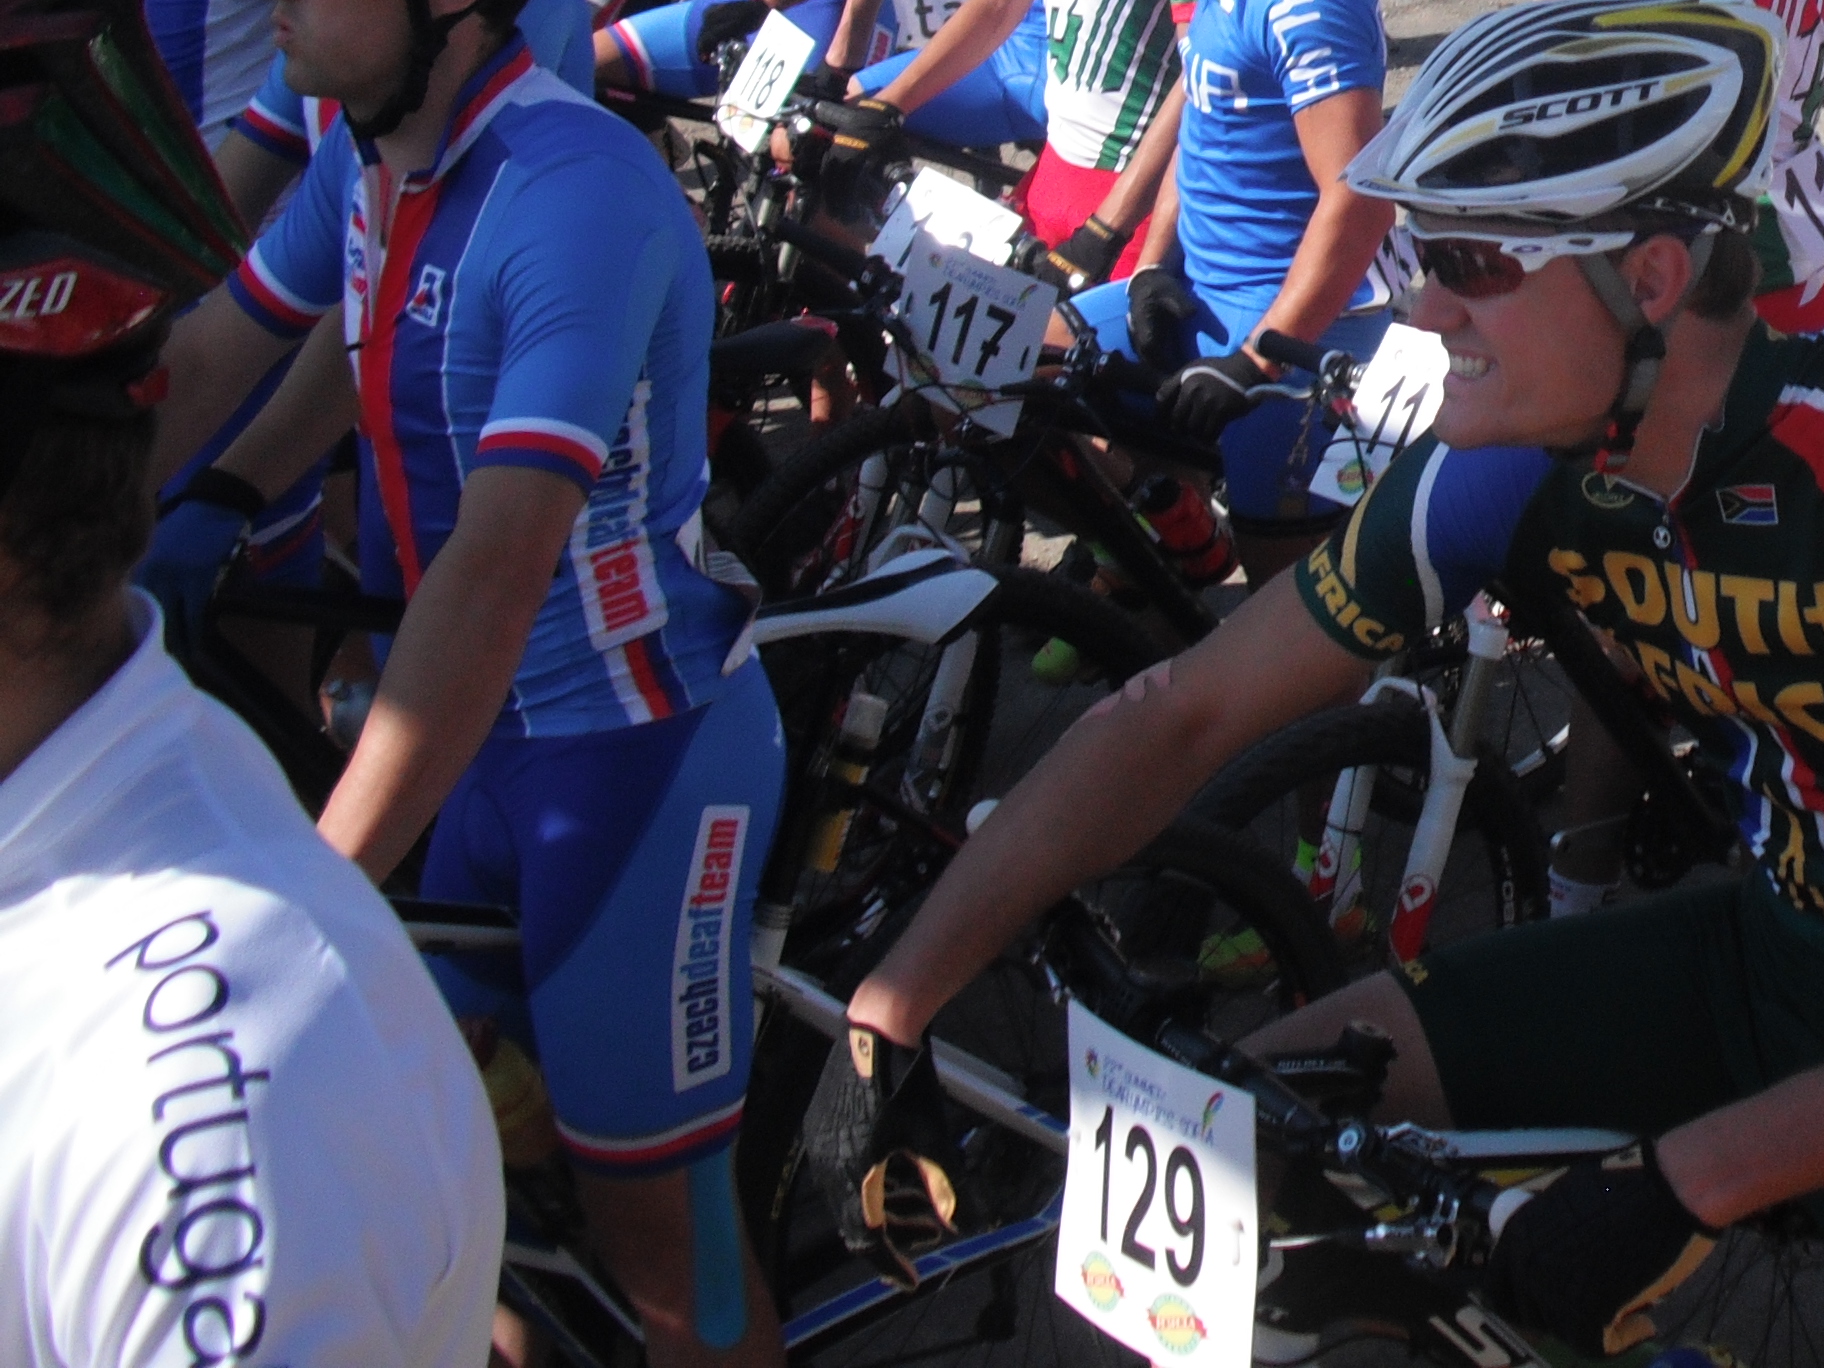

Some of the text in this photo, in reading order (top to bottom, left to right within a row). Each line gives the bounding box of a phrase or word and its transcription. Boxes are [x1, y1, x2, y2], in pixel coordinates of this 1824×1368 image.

[740, 47, 786, 110] 118
[1498, 79, 1661, 131] SCOTT
[928, 281, 1017, 377] 117
[1366, 375, 1431, 462] 11
[1094, 1103, 1206, 1289] 129
